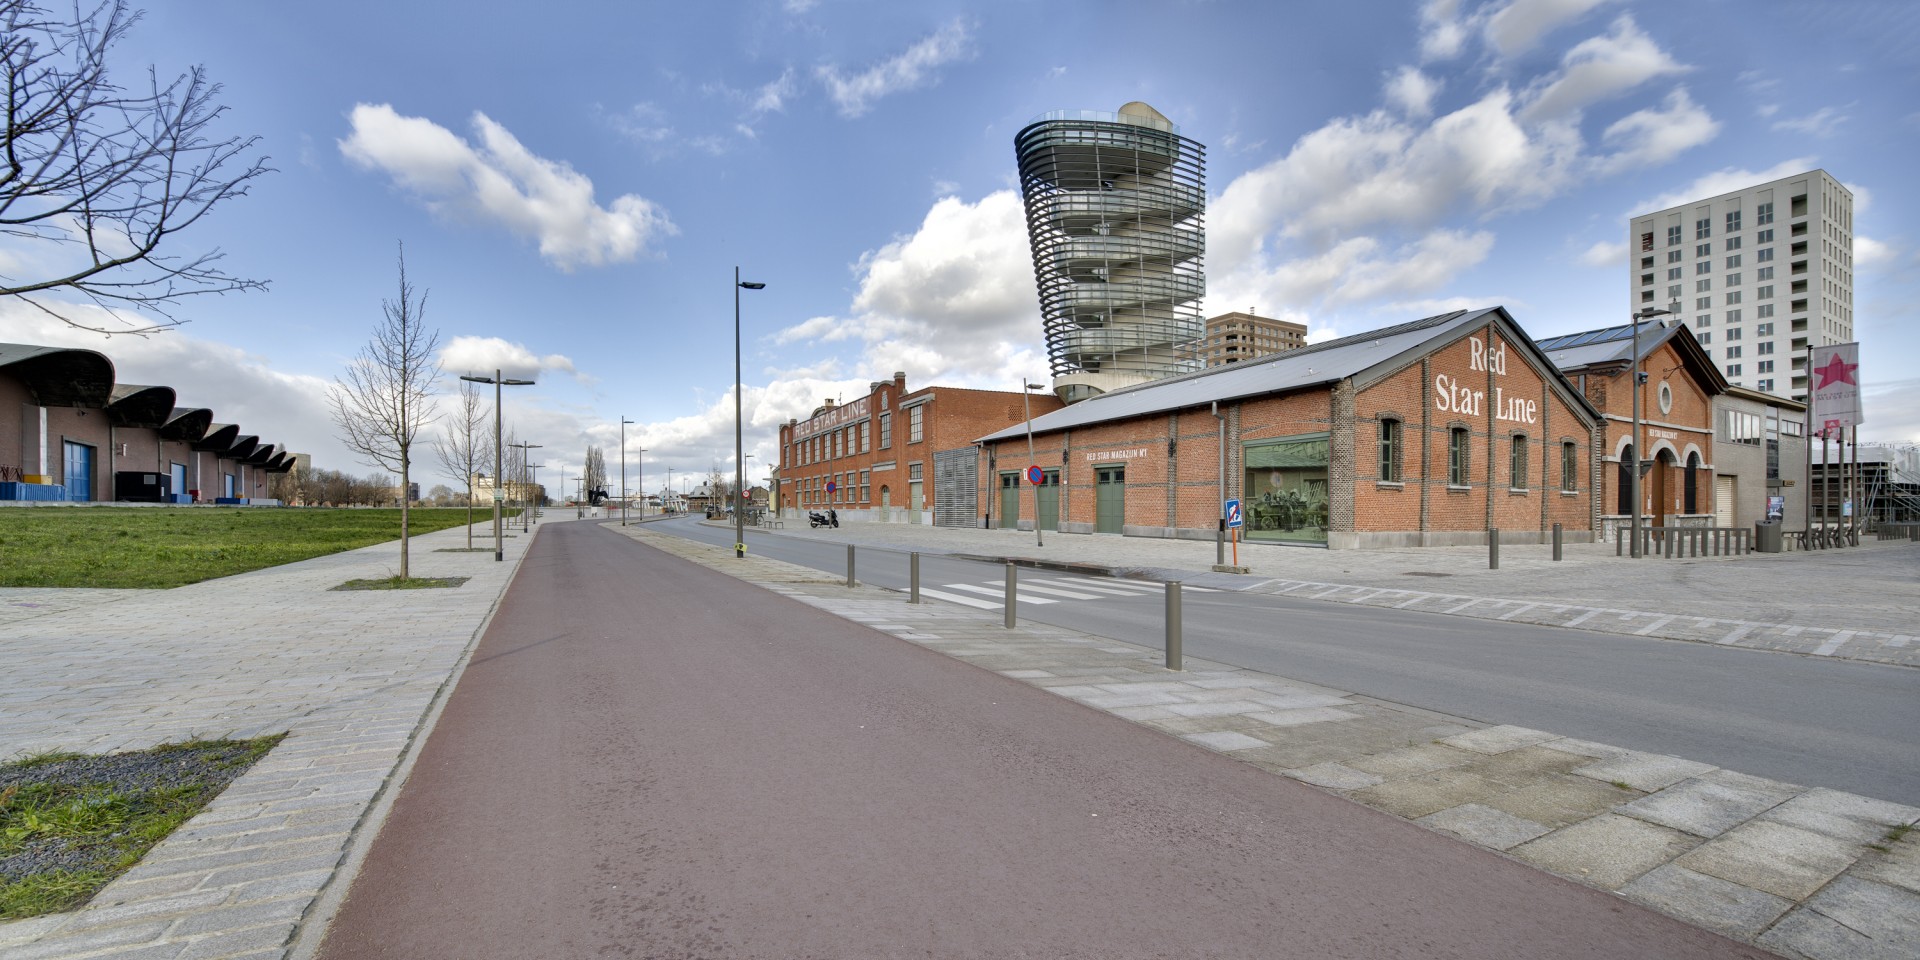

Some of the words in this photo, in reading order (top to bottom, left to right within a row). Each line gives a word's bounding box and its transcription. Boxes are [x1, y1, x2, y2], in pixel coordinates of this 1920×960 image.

[1469, 337, 1506, 376] Red
[795, 420, 811, 438] RED
[813, 410, 837, 431] STAR
[841, 398, 867, 421] LINE
[1435, 374, 1483, 416] Star
[1495, 387, 1537, 424] Line
[1086, 452, 1096, 461] RED
[1097, 451, 1110, 461] STAR
